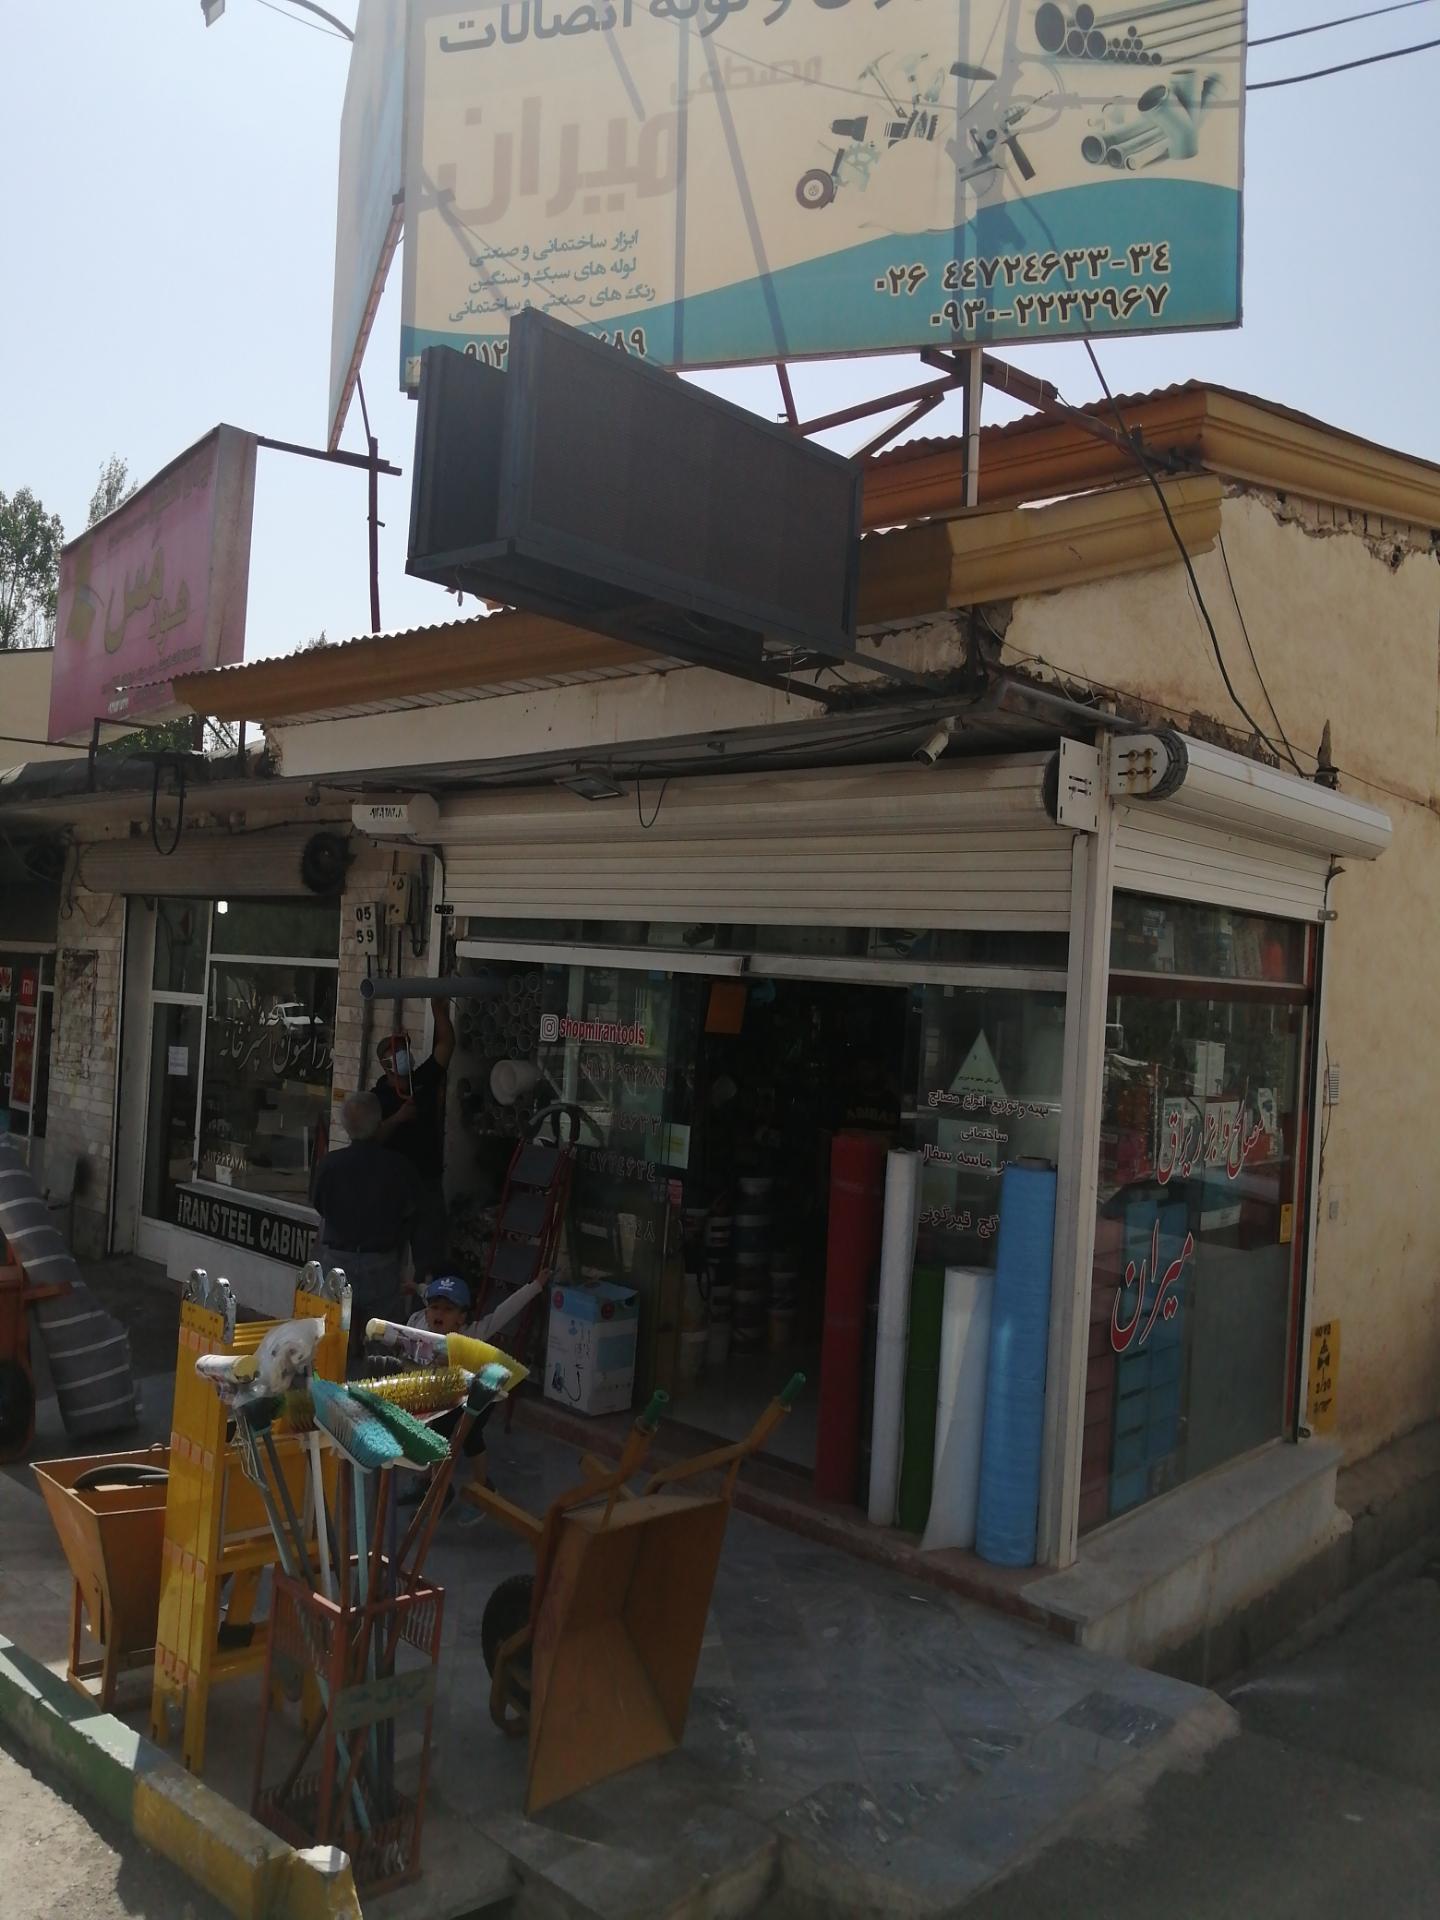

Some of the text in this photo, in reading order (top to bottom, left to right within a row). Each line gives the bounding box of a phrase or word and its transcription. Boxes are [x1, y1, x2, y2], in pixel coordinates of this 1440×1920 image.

[437, 96, 687, 226] میران
[468, 229, 640, 268] ابزار ساختمانی و صنعتی
[468, 256, 638, 294] لوله های سبک و سنگین
[588, 286, 622, 308] های
[625, 282, 656, 303] رنگ
[449, 296, 521, 322] ساختمانی
[355, 906, 372, 921] 05
[356, 929, 374, 944] 59
[560, 1016, 646, 1047] shopmirantools
[928, 1089, 960, 1107] مصالح
[962, 1093, 987, 1111] انواع
[1027, 1103, 1049, 1119] تهیه
[960, 1126, 1009, 1142] ساختمانی
[956, 1150, 993, 1169] ماسه
[177, 1193, 210, 1231] IRAN
[210, 1203, 254, 1246] STEEL
[977, 1215, 1001, 1238] گچ
[1111, 1217, 1194, 1353] میران
